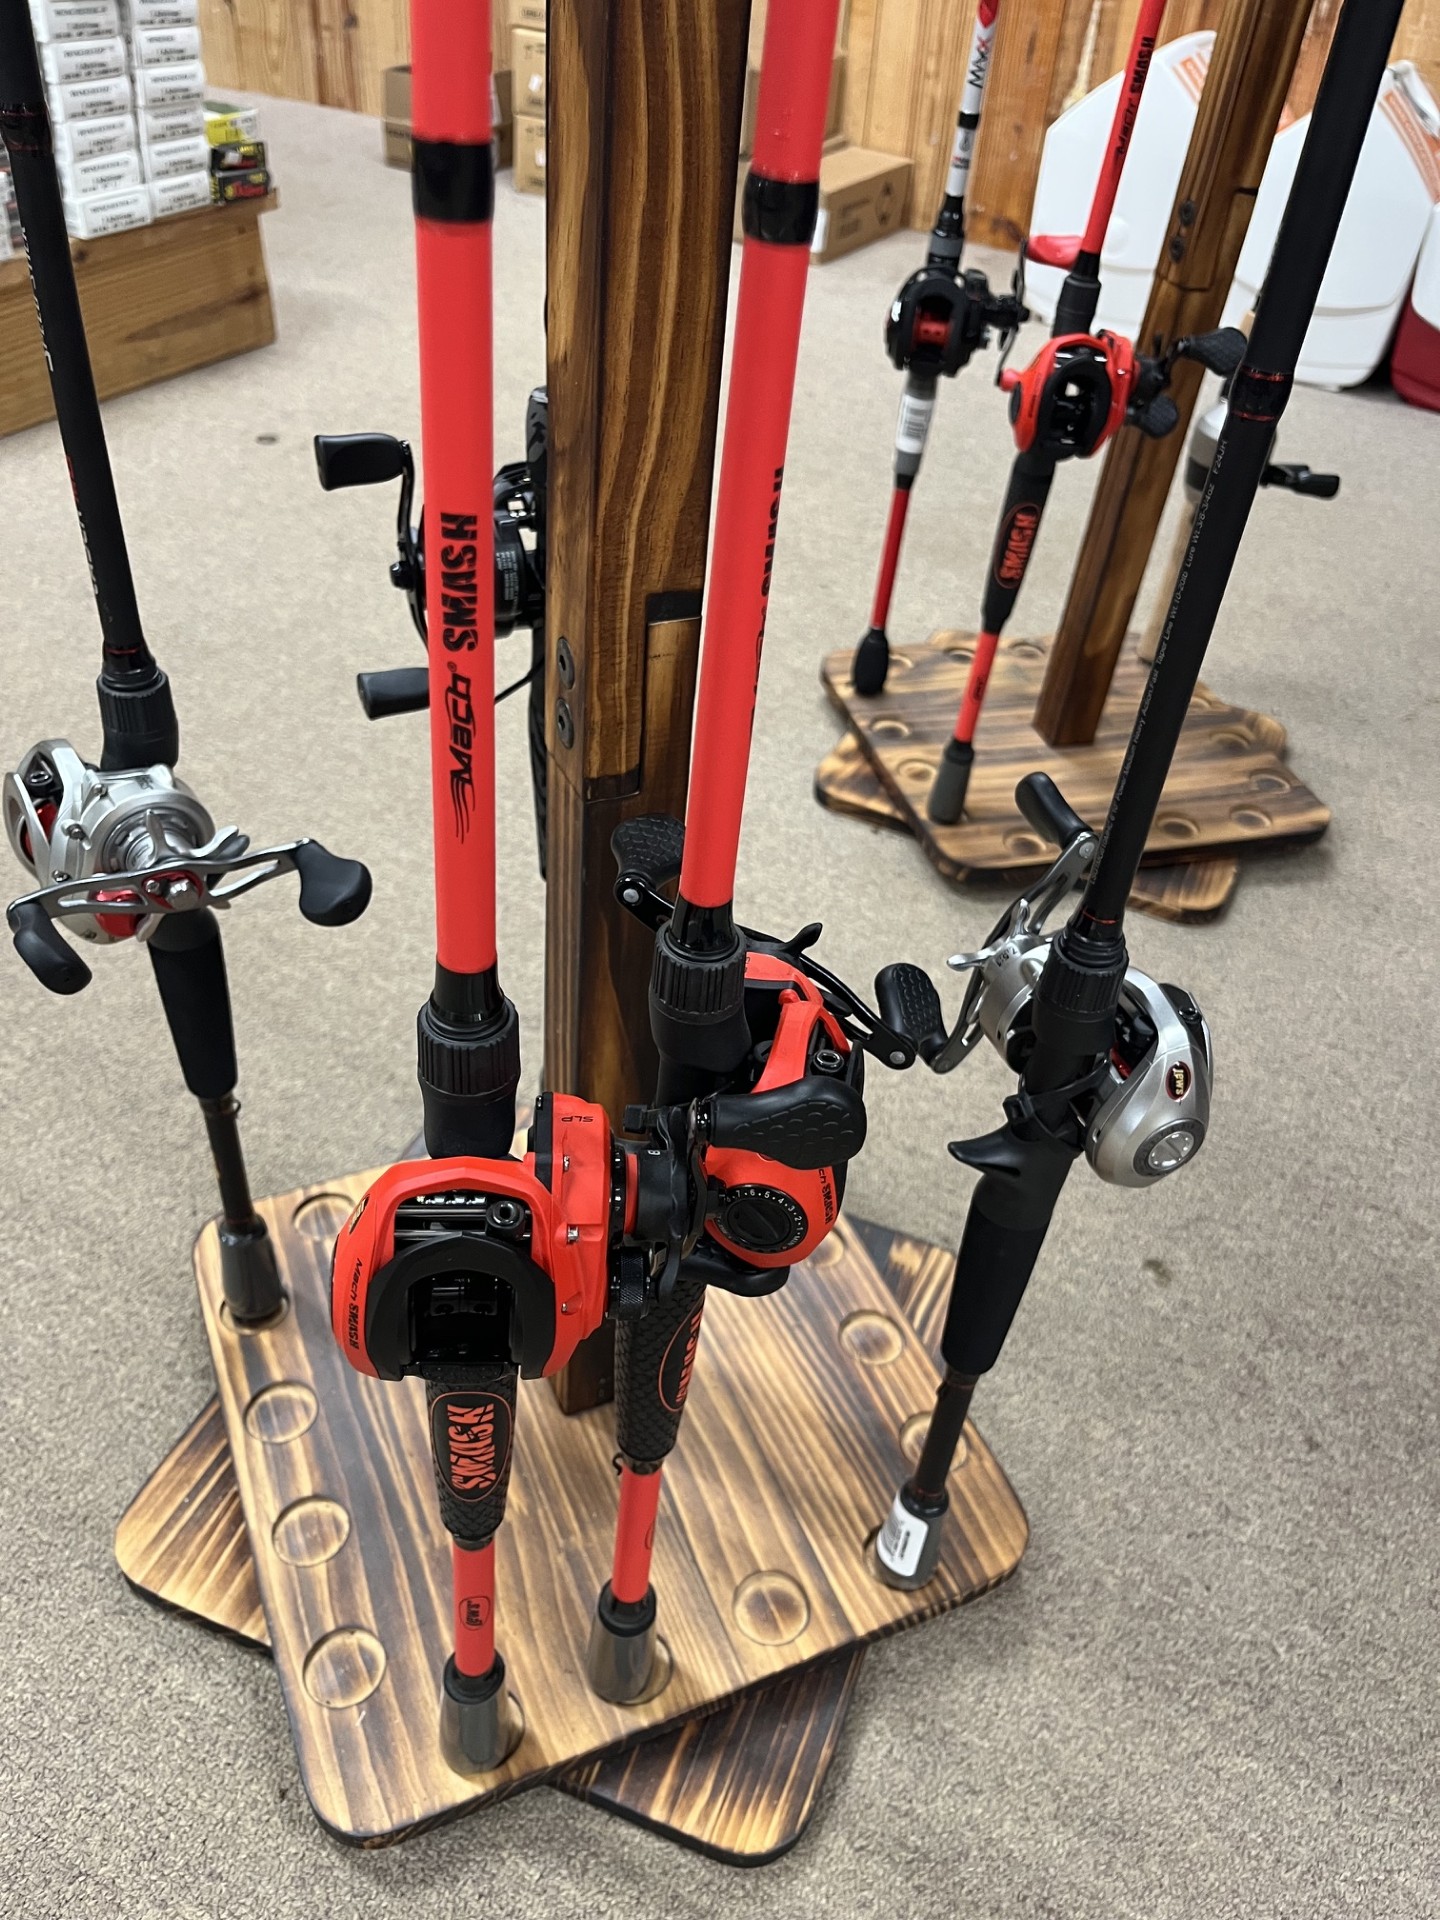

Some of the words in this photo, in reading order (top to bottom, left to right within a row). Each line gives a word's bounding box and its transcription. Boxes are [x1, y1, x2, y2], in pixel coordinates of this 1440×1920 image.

[1000, 512, 1037, 580] SMASH
[440, 512, 479, 652] SMASH
[1157, 642, 1168, 665] Taper
[1163, 620, 1174, 641] Line
[1185, 542, 1196, 568] Lure
[561, 1115, 594, 1123] SLP
[764, 1191, 771, 1199] 5
[821, 1183, 834, 1225] SMASH
[348, 1302, 360, 1350] SMASH
[446, 1403, 497, 1491] SMASH
